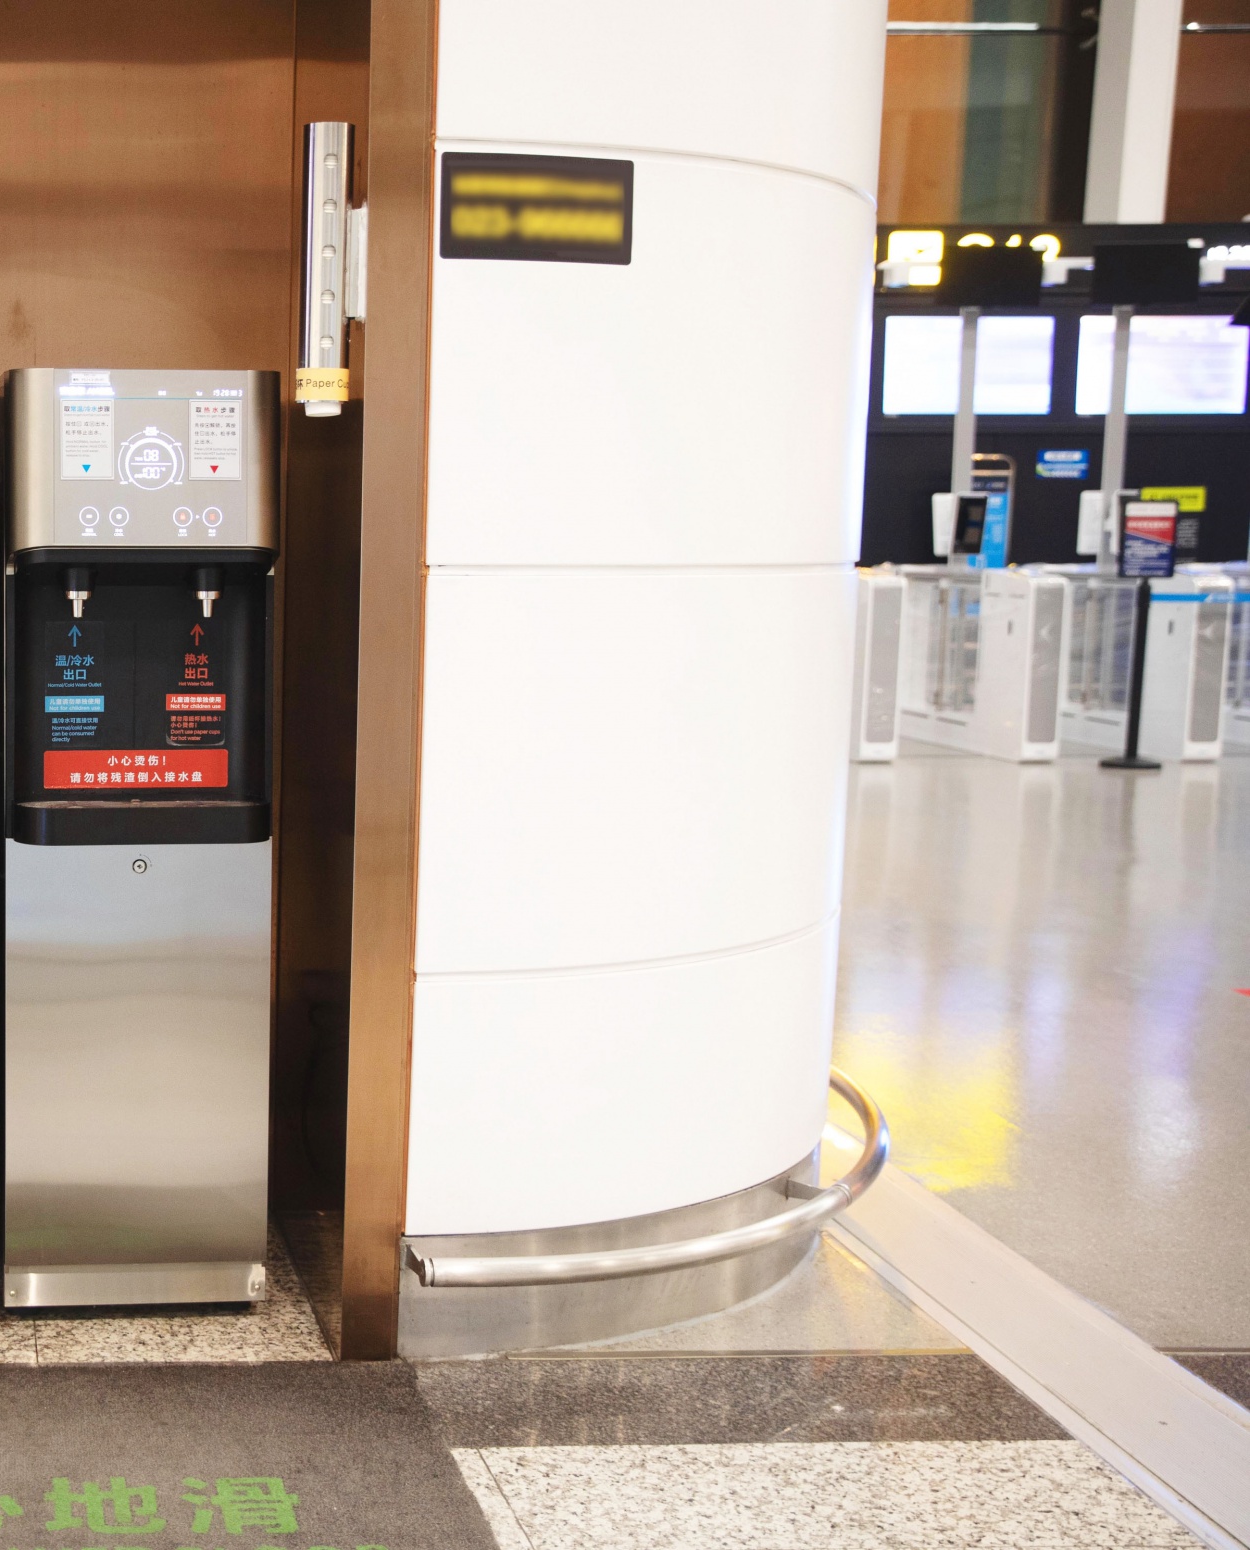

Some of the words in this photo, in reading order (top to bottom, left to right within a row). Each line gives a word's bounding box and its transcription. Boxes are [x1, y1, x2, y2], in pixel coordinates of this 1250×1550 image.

[306, 379, 335, 389] Paper
[55, 654, 95, 667] 温/冷水
[184, 653, 209, 665] 热水
[63, 668, 87, 680] 出口
[184, 667, 208, 679] 出口
[107, 755, 166, 767] 小心烫伤！
[70, 771, 203, 783] 请勿将残渣倒入接水盘
